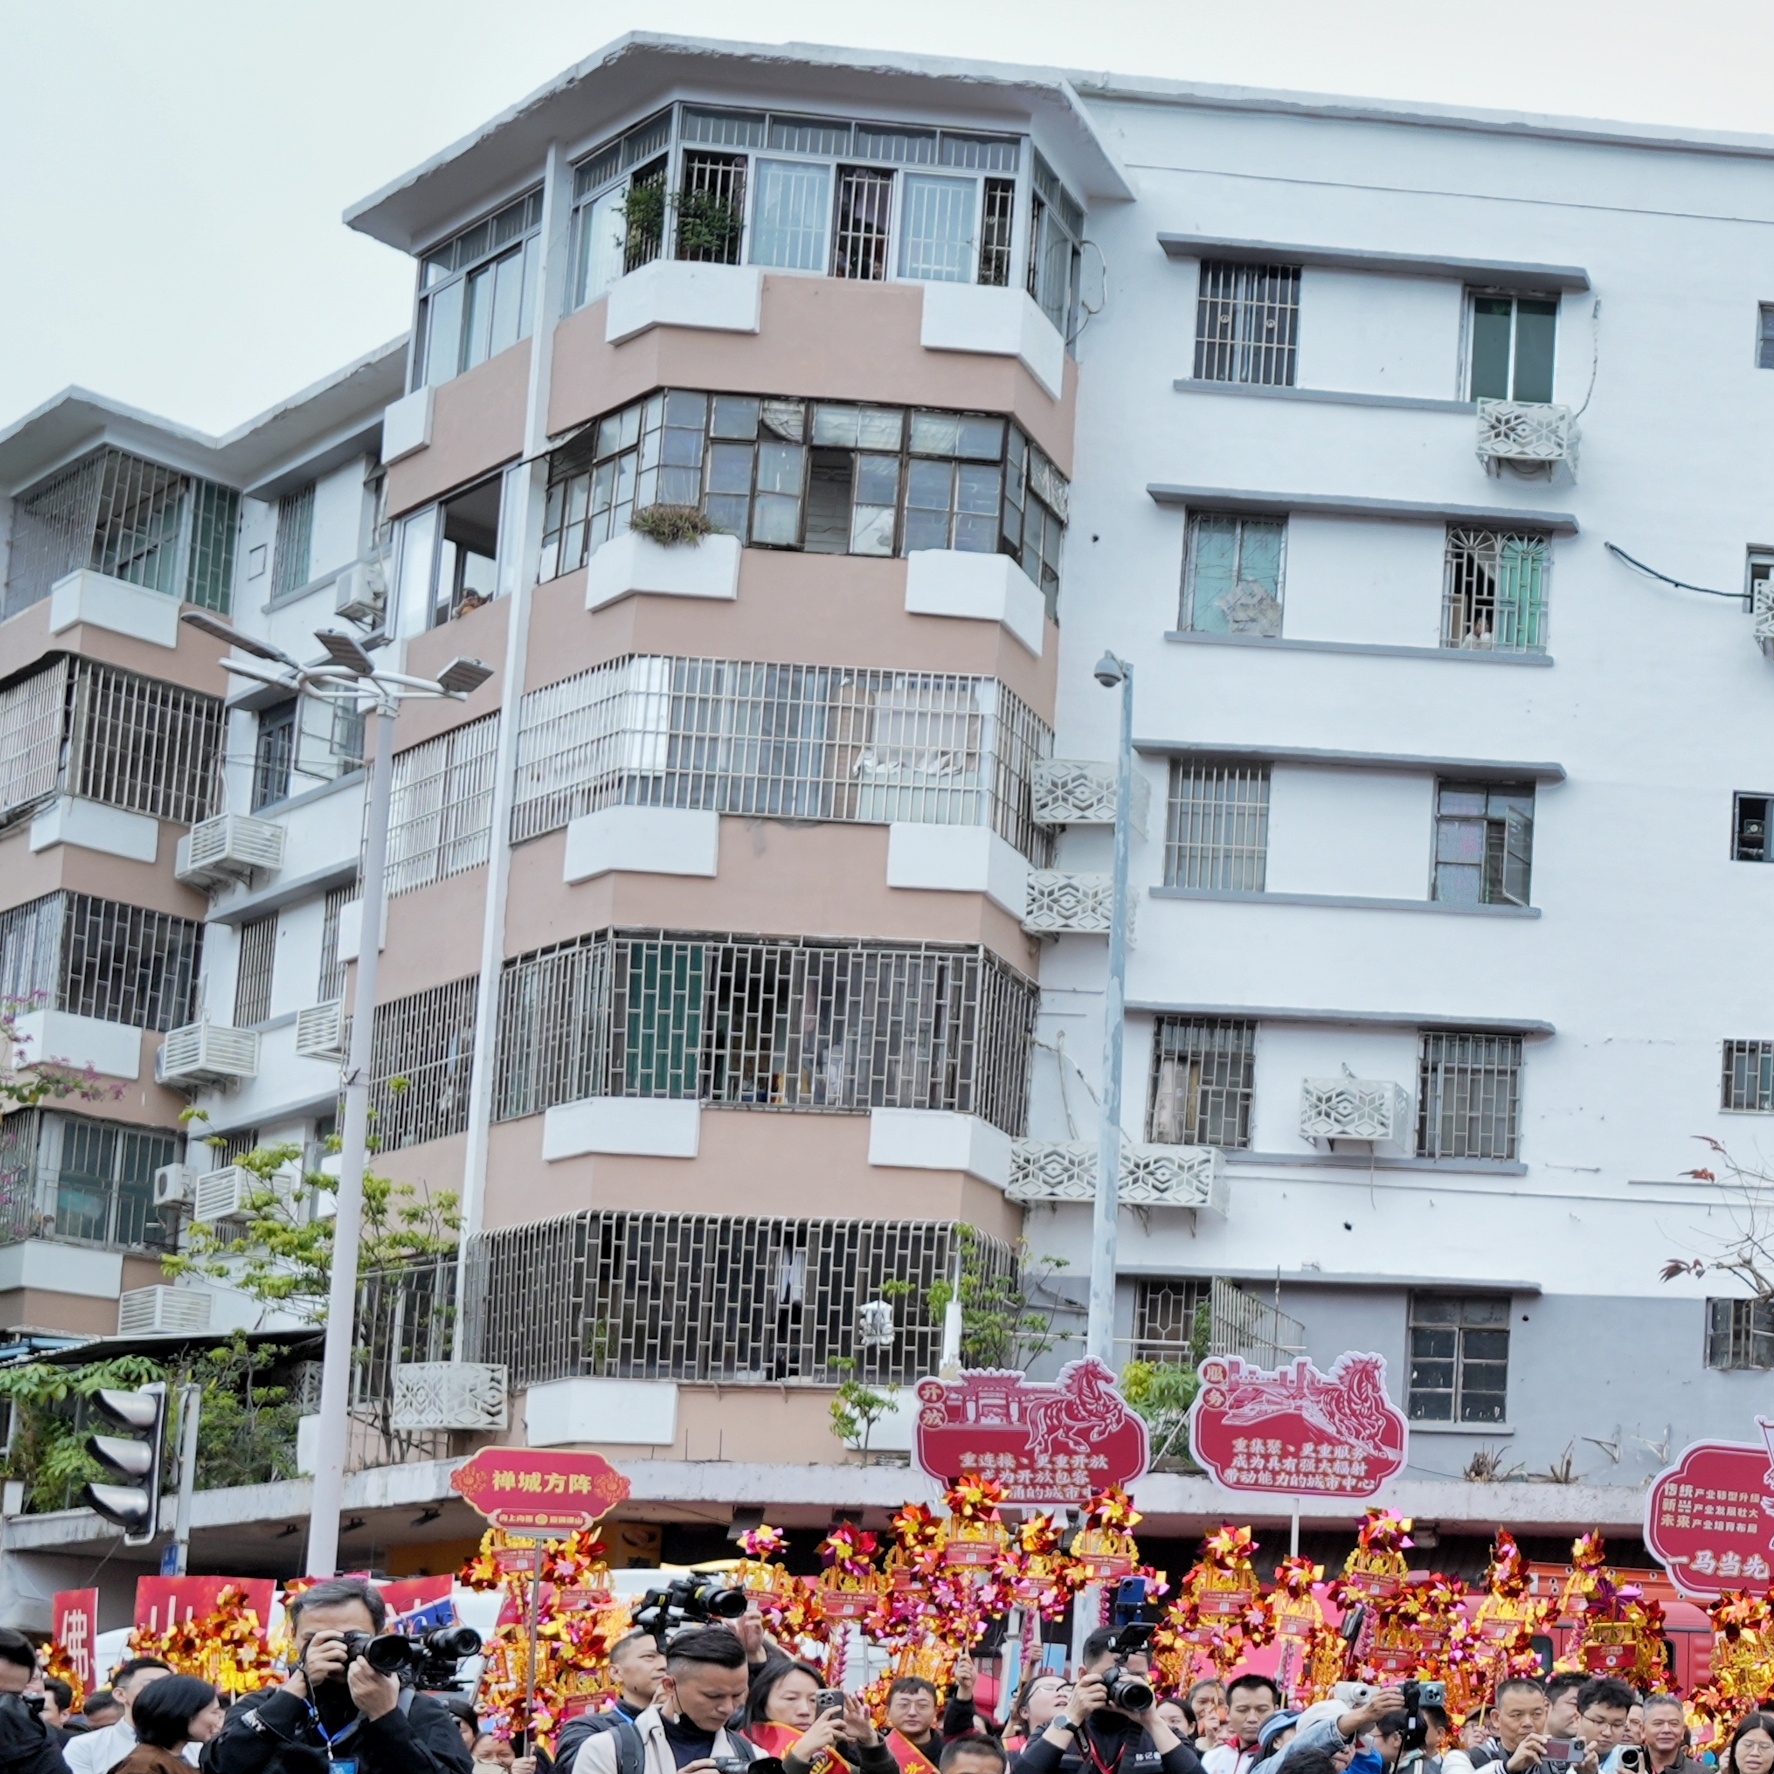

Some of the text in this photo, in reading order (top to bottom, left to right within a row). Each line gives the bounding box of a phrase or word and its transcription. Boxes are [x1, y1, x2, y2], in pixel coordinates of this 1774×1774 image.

[492, 1470, 593, 1494] 禅城方阵
[1661, 1513, 1758, 1534] 未来产业培育布局
[1666, 1549, 1770, 1579] 一马当先
